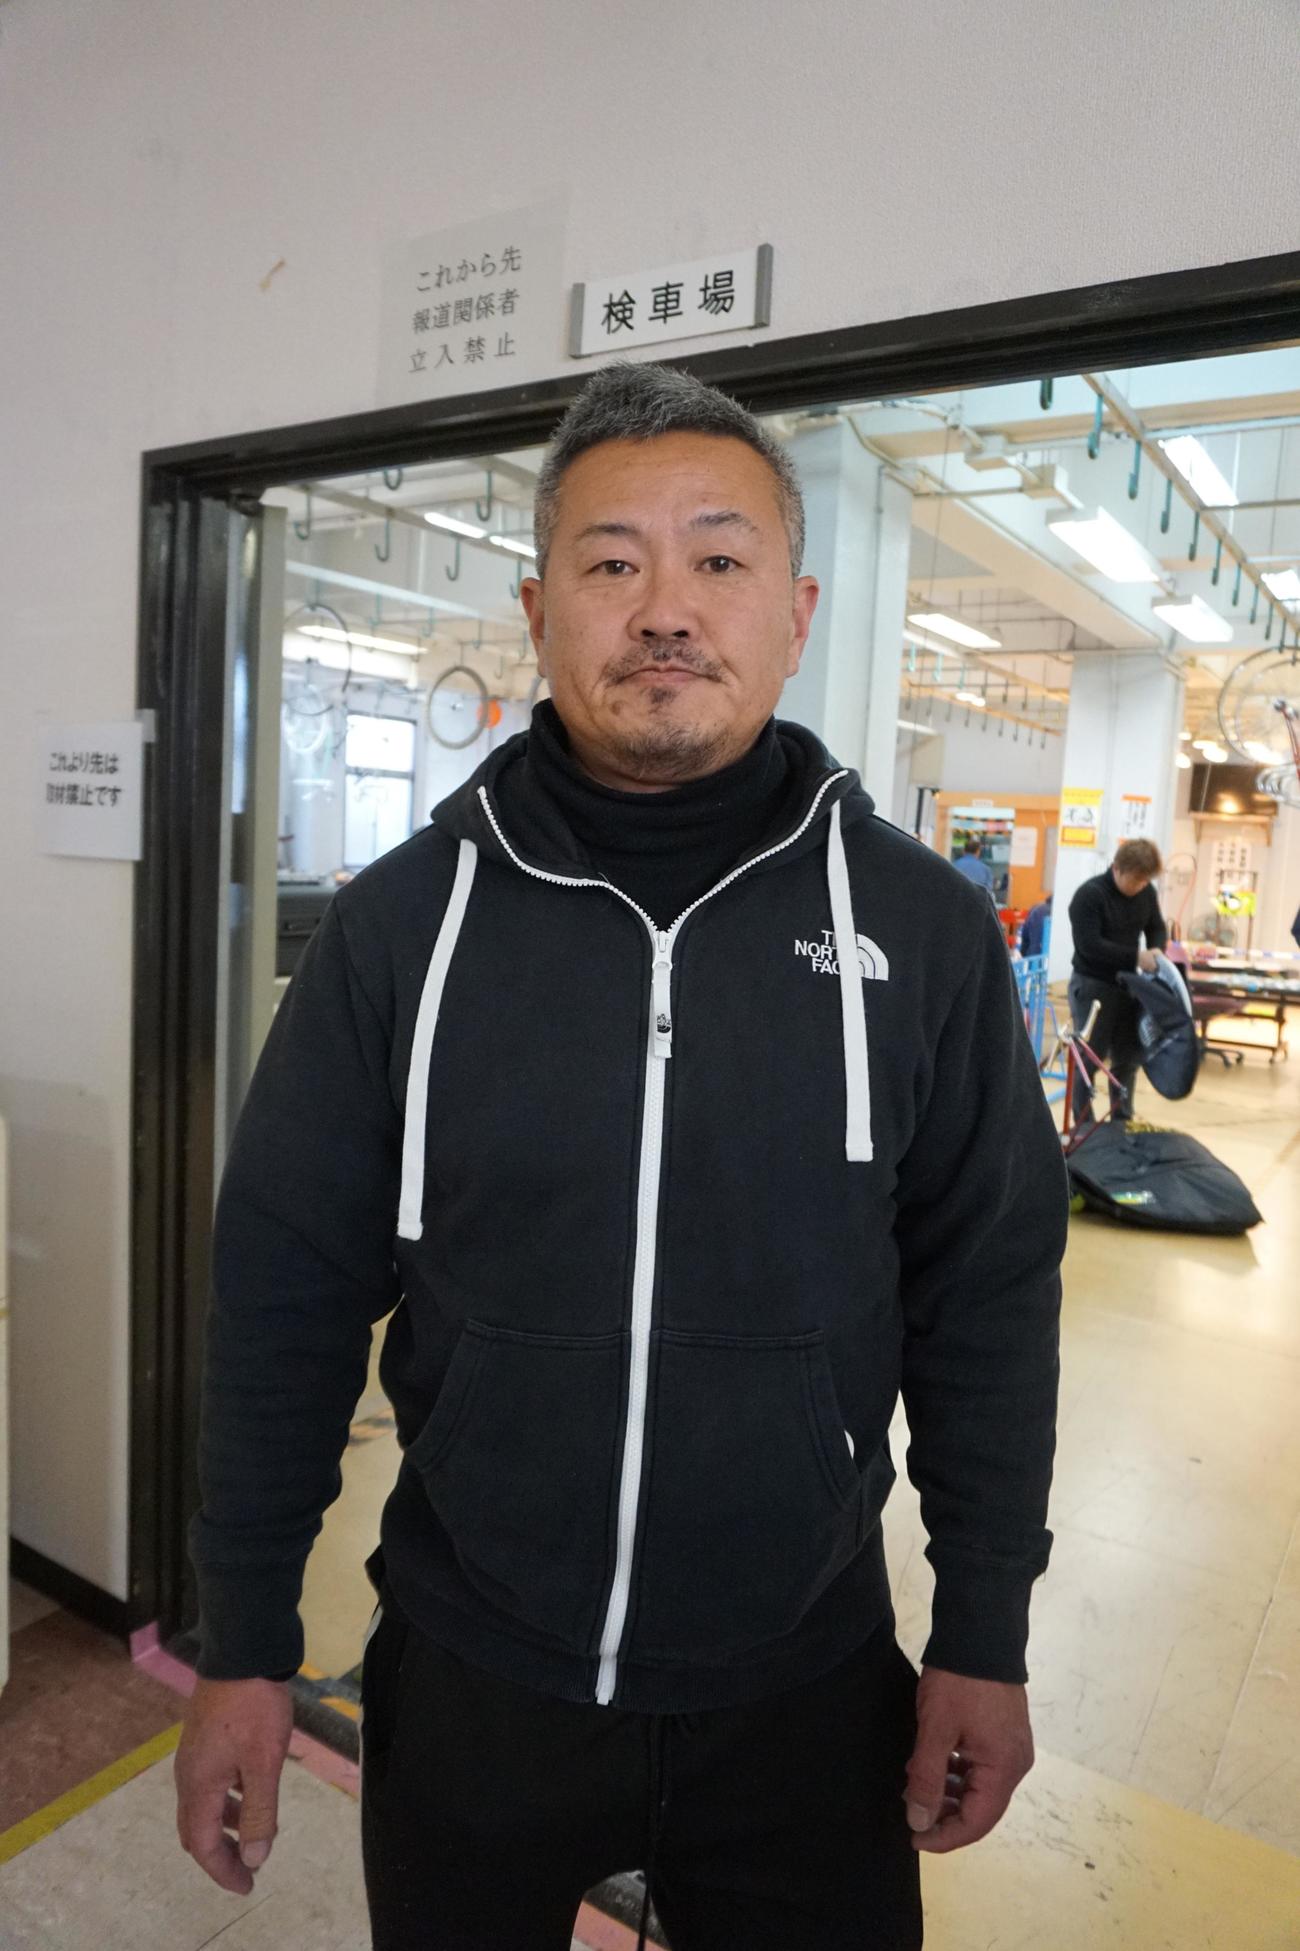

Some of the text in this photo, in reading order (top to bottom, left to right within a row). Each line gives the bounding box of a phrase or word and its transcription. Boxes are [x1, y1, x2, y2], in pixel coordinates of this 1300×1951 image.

[416, 245, 522, 292] これから先
[412, 288, 520, 335] 報道関係者
[601, 270, 735, 335] 検車場
[408, 331, 516, 374] 立入禁止
[49, 752, 119, 774] これより先は
[794, 939, 838, 960] NOR
[812, 957, 841, 975] FAC
